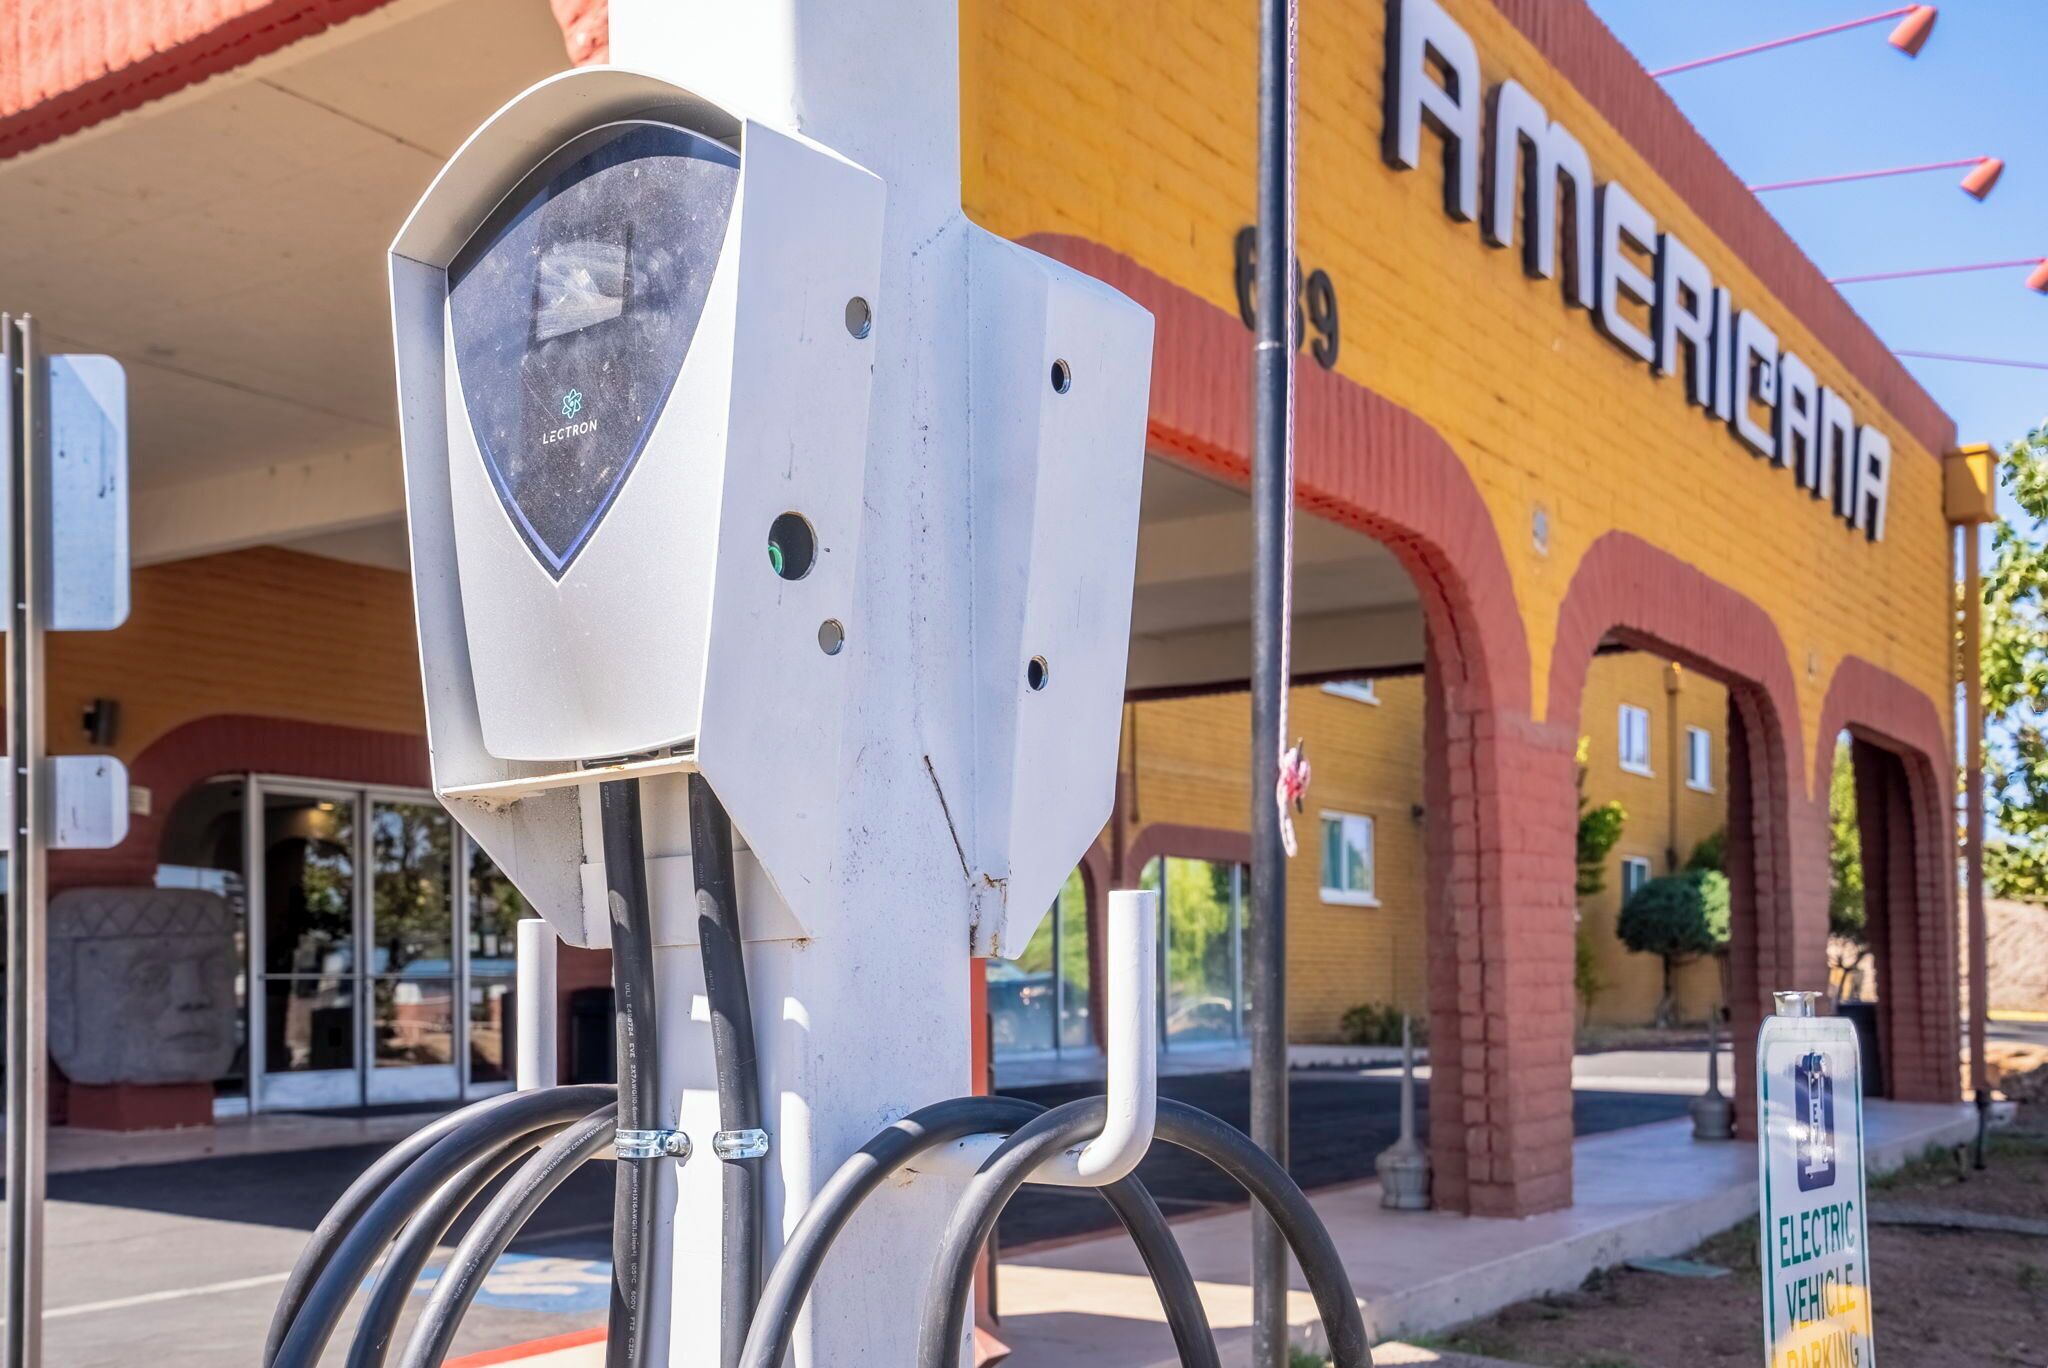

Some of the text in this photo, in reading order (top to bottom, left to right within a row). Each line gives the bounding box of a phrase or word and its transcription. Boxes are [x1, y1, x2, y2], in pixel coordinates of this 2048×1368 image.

[1384, 0, 1892, 543] AMERICANA
[542, 419, 598, 445] LECTRON
[1779, 1200, 1856, 1268] ELECTRIC
[1785, 1262, 1856, 1332] VEHICLE
